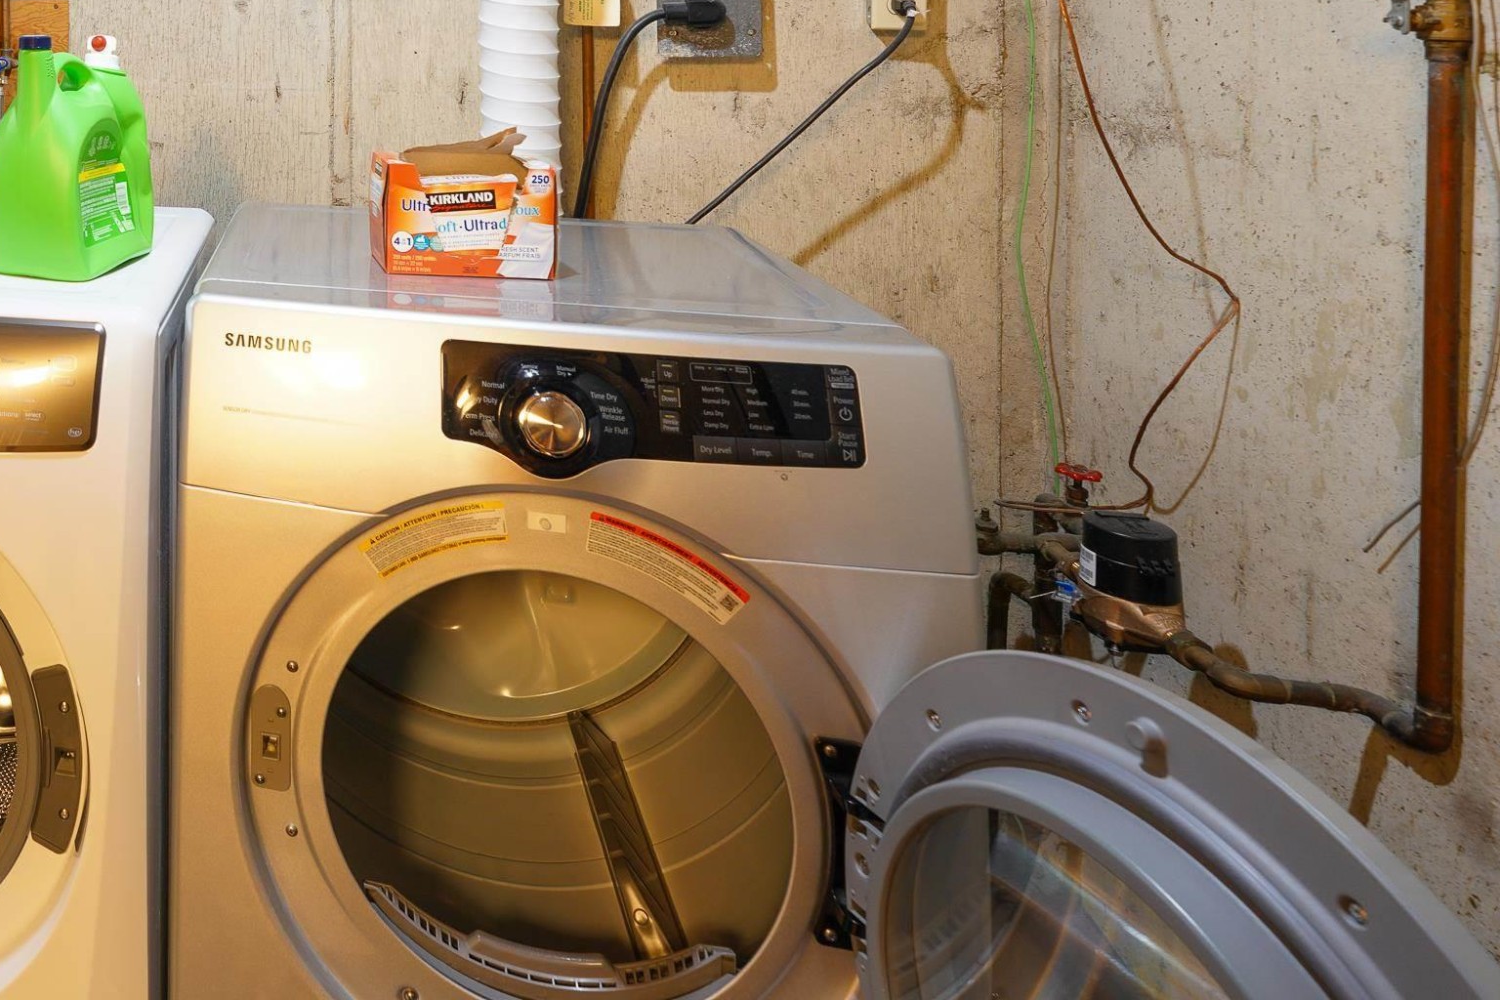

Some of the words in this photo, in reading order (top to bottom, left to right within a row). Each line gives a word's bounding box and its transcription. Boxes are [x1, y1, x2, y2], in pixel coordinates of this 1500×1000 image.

[531, 174, 550, 185] 250
[429, 192, 494, 205] KIRKLAND
[224, 332, 312, 354] SAMSUNG
[663, 370, 673, 379] Up
[481, 380, 505, 390] Normal
[483, 396, 498, 405] Duty
[590, 391, 605, 400] Time
[606, 393, 617, 402] Dry
[833, 396, 855, 405] Power
[599, 406, 623, 414] Wrinkle
[479, 413, 496, 422] Press
[602, 413, 626, 422] Release
[604, 425, 614, 433] Air
[614, 427, 629, 436] Fluff
[838, 440, 858, 448] Pause
[700, 445, 715, 455] Dry
[716, 446, 733, 455] Level
[797, 450, 815, 459] Time
[375, 526, 401, 542] CAUTION
[403, 512, 437, 528] ATTENTION
